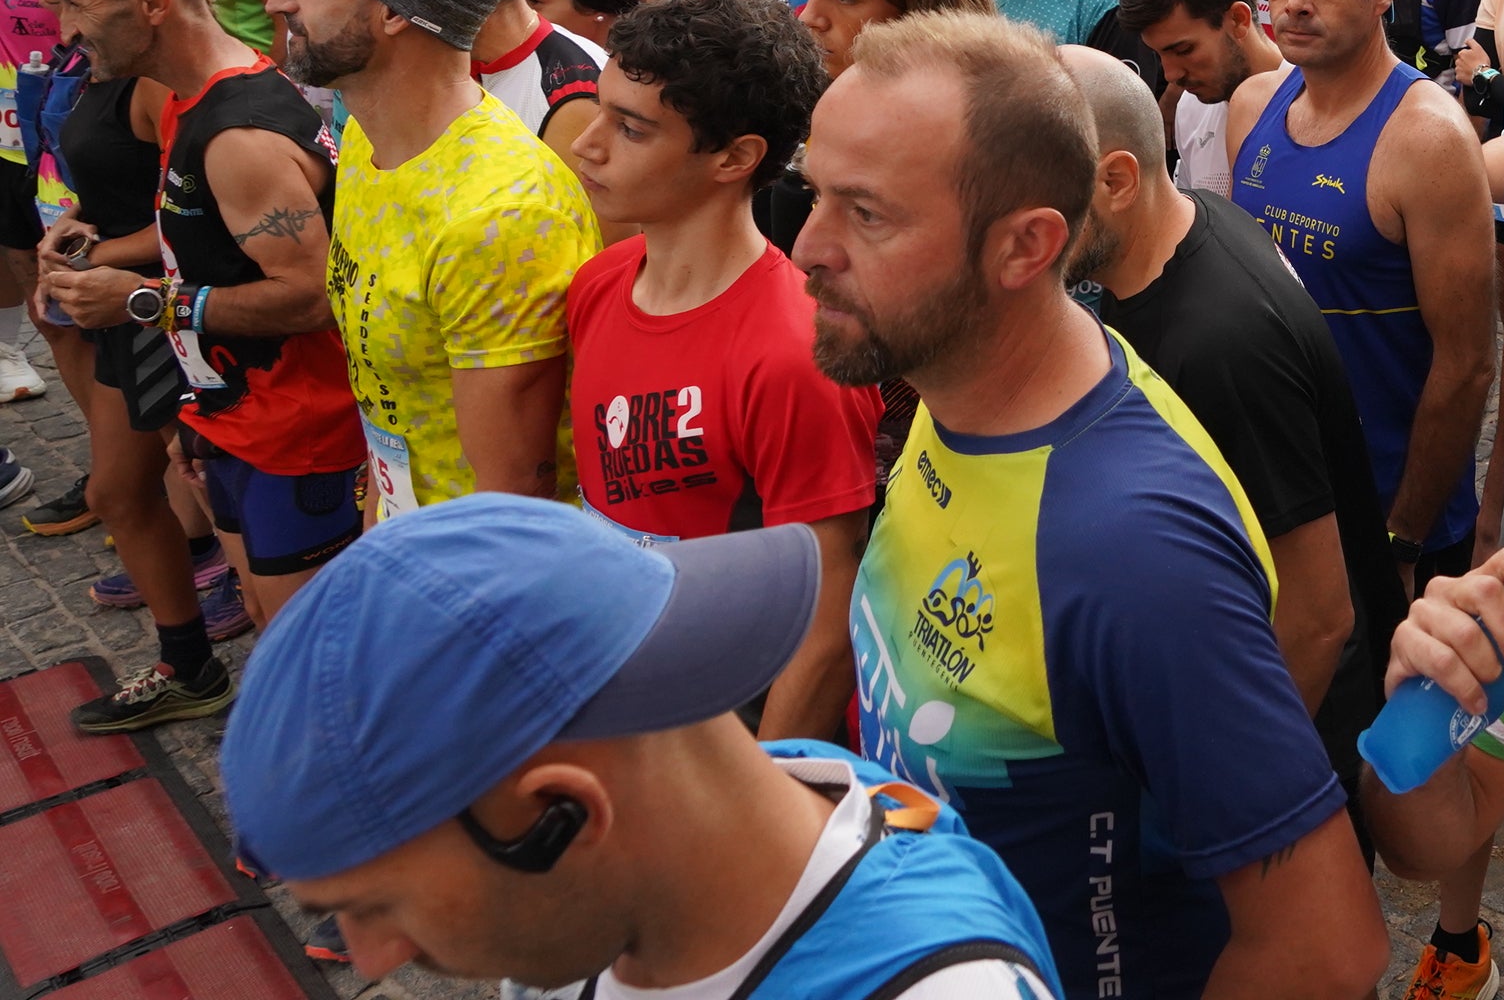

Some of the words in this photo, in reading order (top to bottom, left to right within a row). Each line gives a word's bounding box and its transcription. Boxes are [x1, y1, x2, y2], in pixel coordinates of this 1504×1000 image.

[1312, 174, 1345, 194] Spiuk
[1257, 218, 1336, 260] NTES
[1265, 205, 1287, 221] CLUB
[1289, 211, 1341, 238] DEPORTIVO
[600, 438, 708, 482] RUEDAS
[606, 472, 718, 505] Bikes
[913, 609, 976, 684] TRIATLÓN
[1089, 875, 1122, 998] PUENTE
